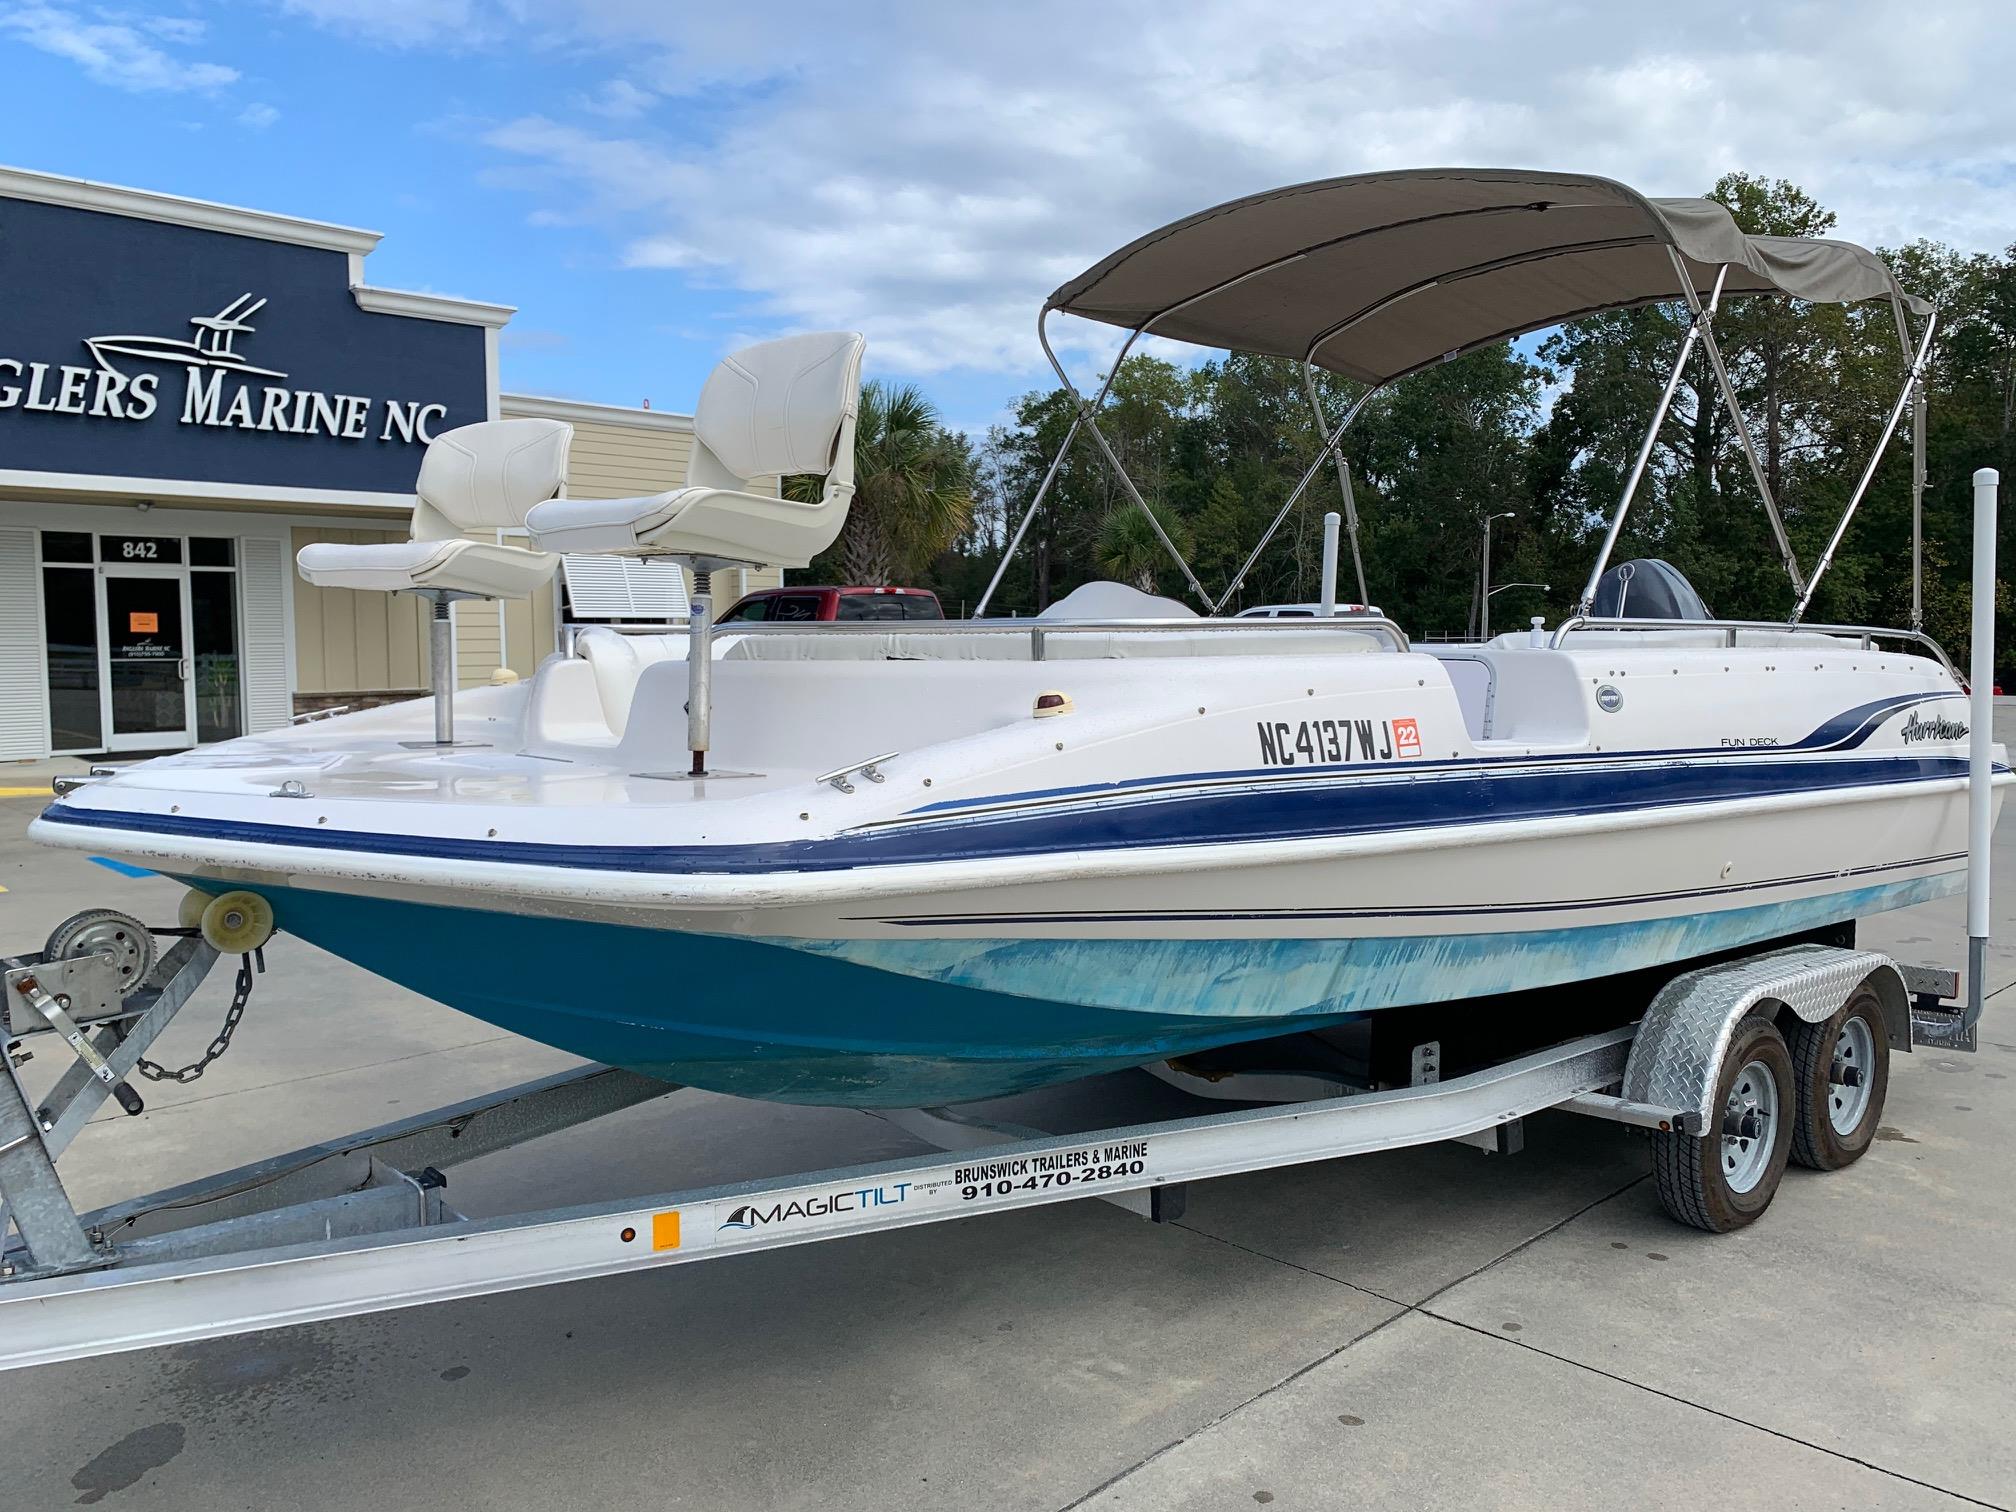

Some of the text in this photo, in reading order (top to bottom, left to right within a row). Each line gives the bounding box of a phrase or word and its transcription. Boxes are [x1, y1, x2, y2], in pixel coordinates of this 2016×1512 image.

[180, 365, 372, 439] MARINE
[379, 400, 447, 445] NC
[122, 541, 158, 559] 842
[1397, 726, 1418, 745] 22
[1901, 710, 1970, 745] Hurricane
[1721, 737, 1779, 748] FUN DECK
[954, 1142, 1148, 1185] BRUNSWICK TRAILERS & MARINE
[913, 1180, 953, 1191] DISTRIBUTED
[961, 1160, 1145, 1201] 910-470-2840
[928, 1188, 938, 1196] BY
